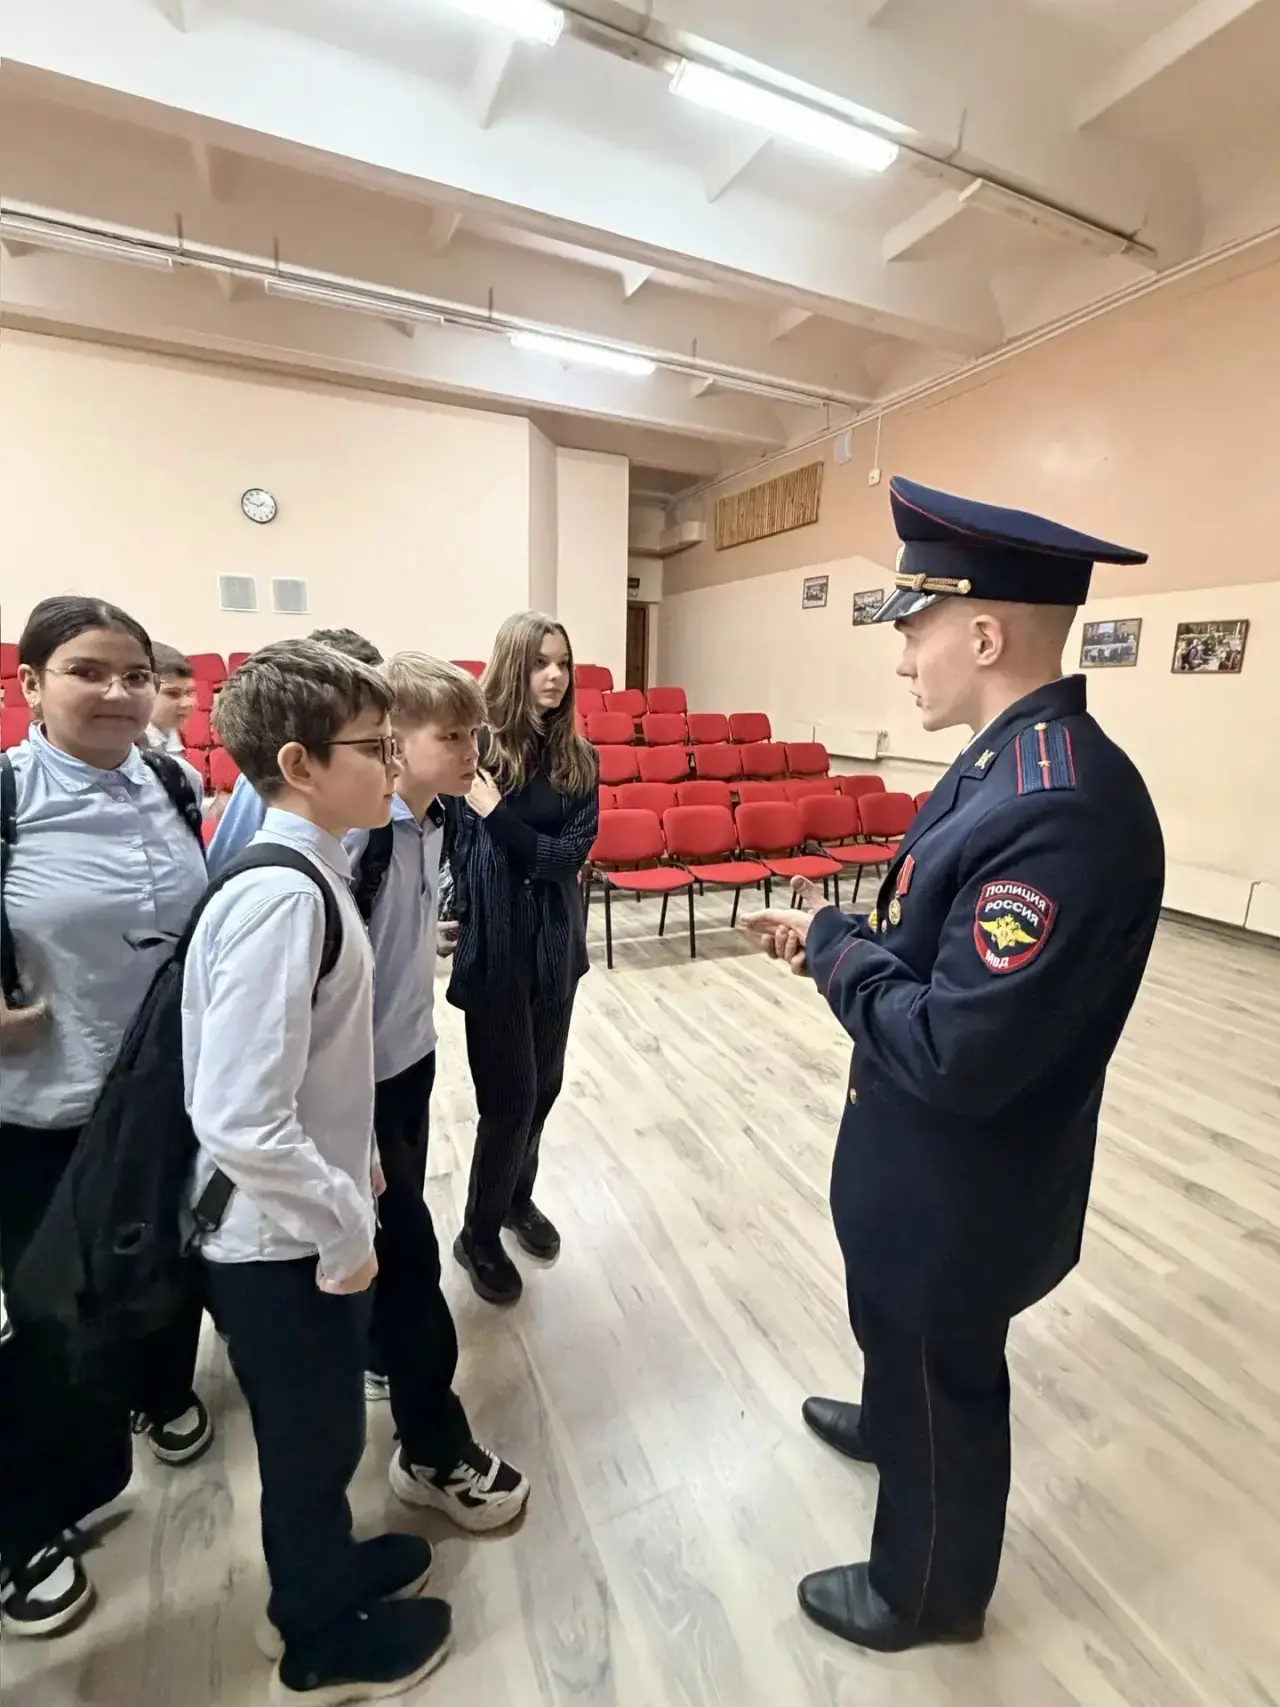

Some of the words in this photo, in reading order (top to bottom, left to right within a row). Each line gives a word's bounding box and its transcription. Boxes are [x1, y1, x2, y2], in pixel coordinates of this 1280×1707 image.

[985, 885, 1046, 912] ПОЛИЦИЯ
[984, 900, 1039, 927] РОССИЯ
[985, 949, 1009, 969] МВД
